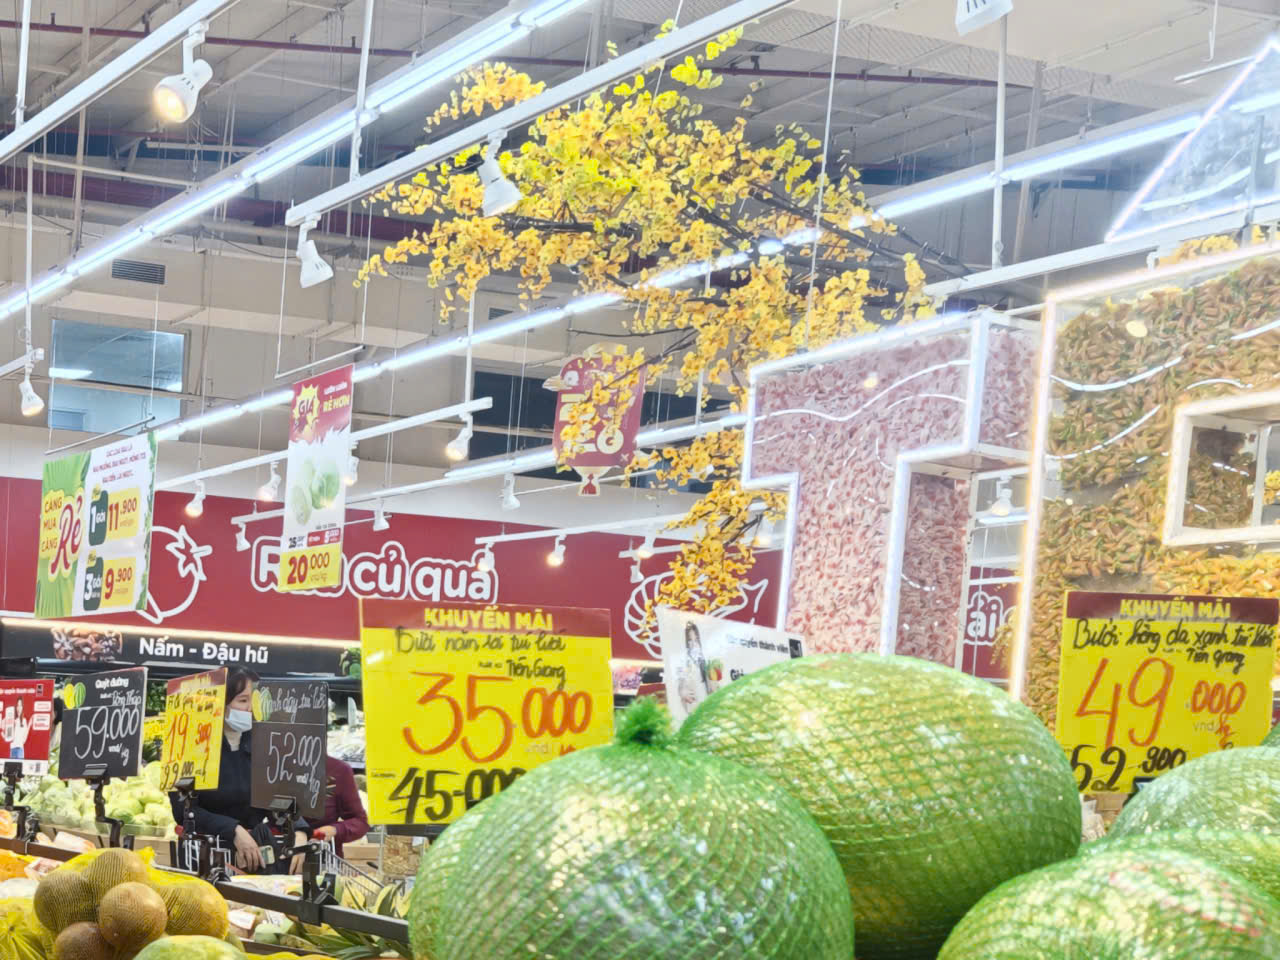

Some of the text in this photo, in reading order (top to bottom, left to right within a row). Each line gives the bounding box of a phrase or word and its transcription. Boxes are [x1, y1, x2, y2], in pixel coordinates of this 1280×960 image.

[354, 546, 401, 595] củ
[424, 606, 553, 631] KHUYẾN MÃI
[1120, 597, 1231, 619] KHUYẾN MÃI
[140, 636, 184, 660] Nấm
[202, 639, 241, 665] Đậu
[245, 642, 269, 664] hũ
